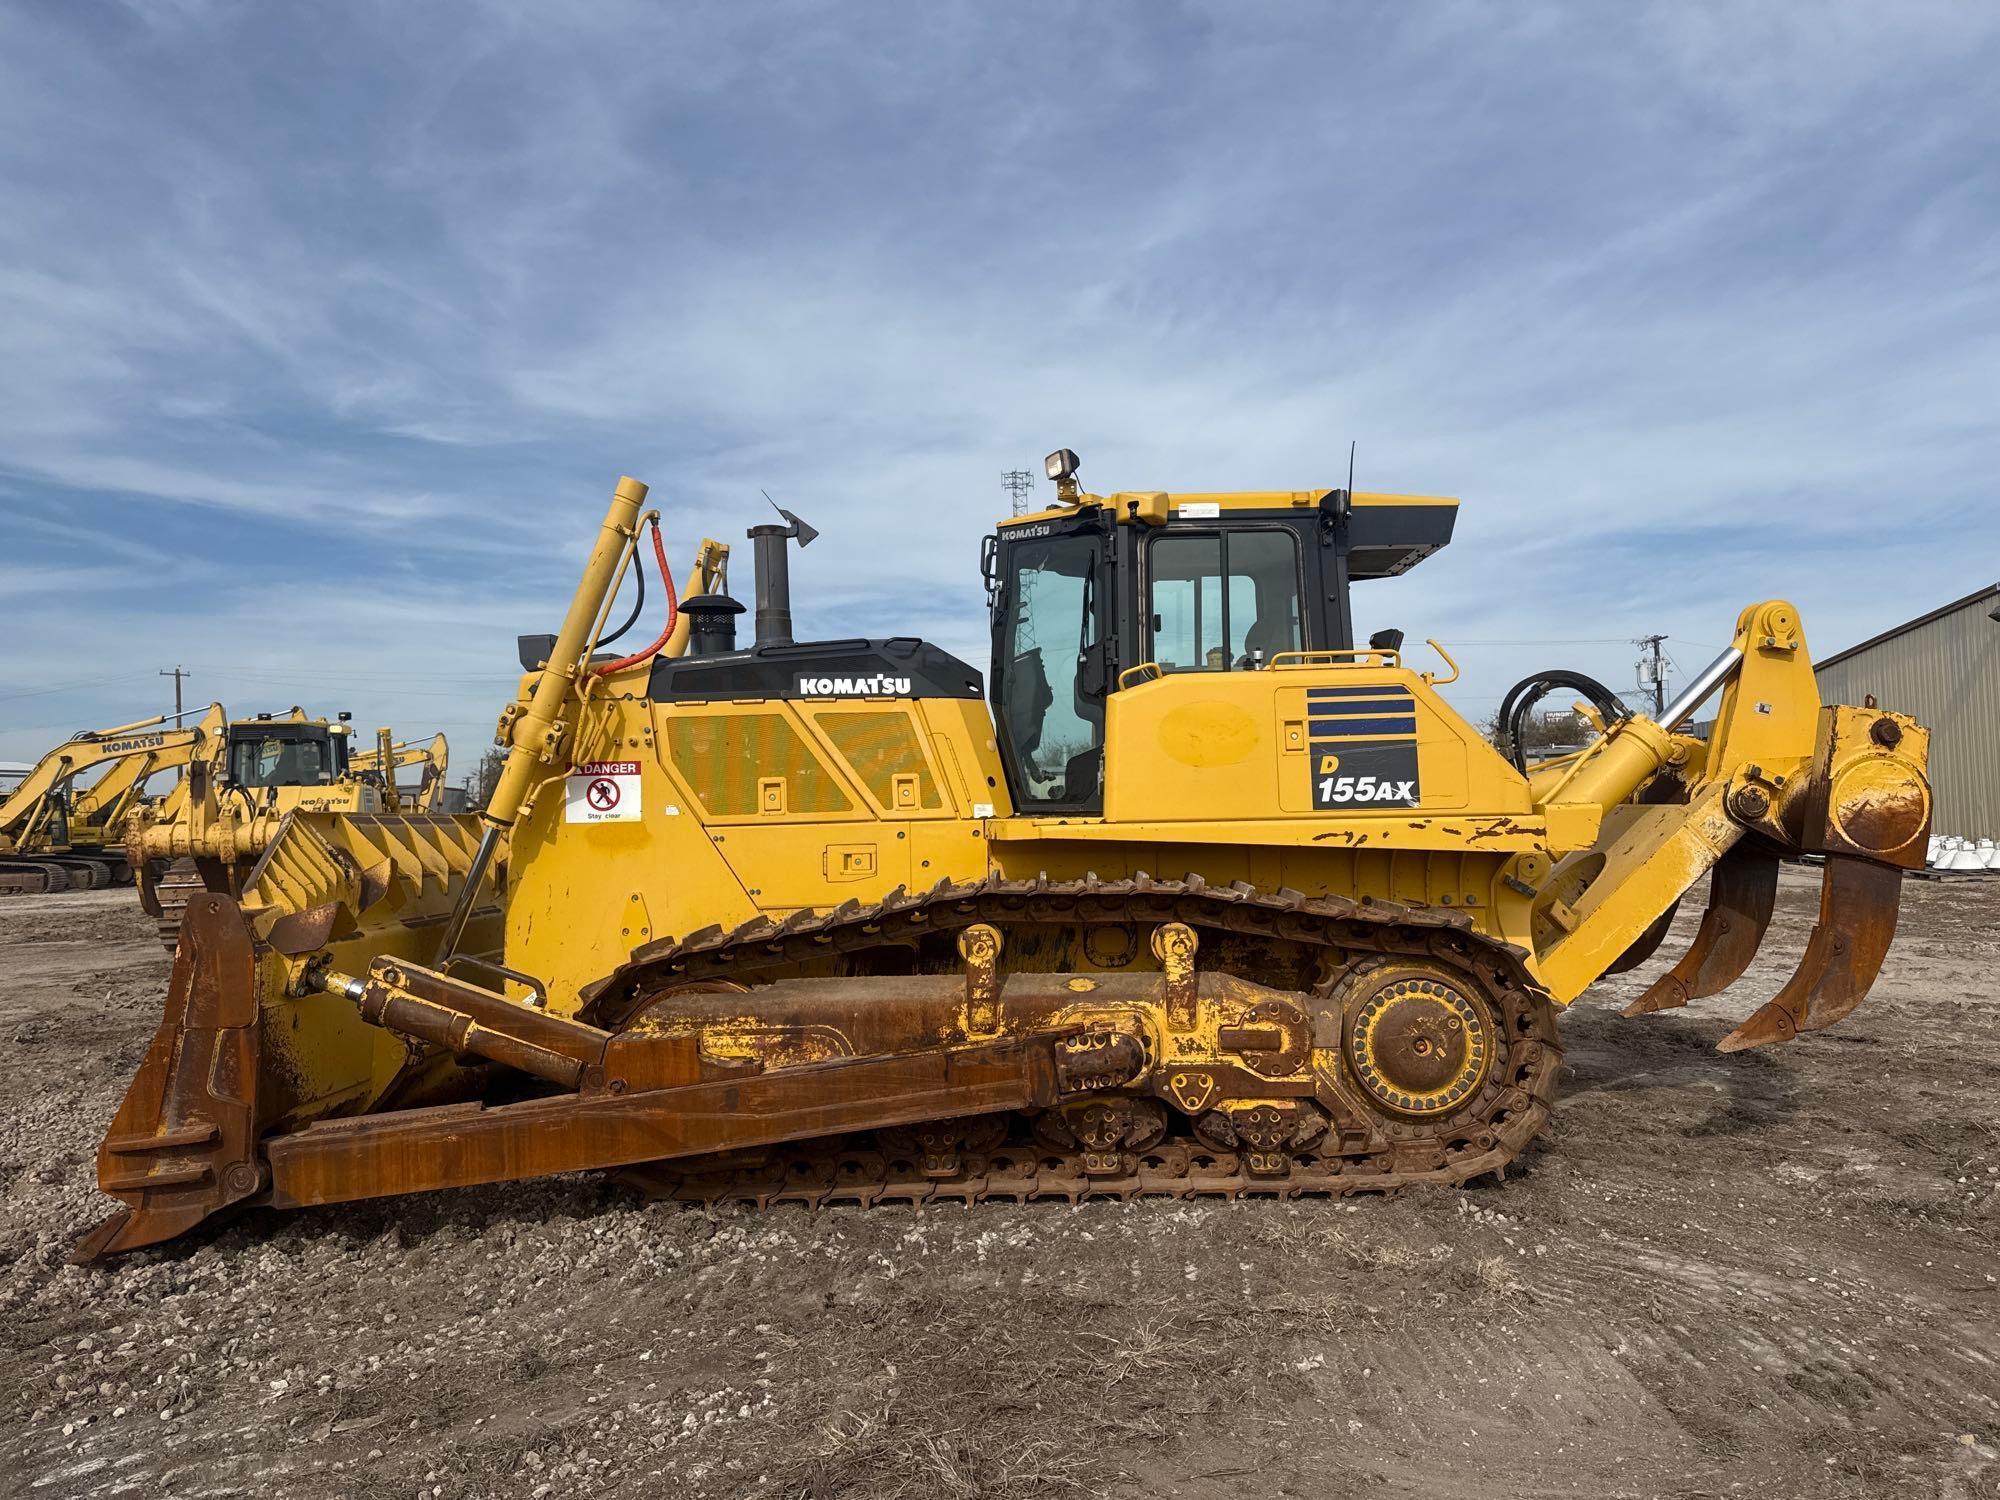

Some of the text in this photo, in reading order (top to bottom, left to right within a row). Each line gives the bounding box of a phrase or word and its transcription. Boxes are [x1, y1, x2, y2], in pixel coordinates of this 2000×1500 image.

[1002, 525, 1050, 540] KOMATSU
[800, 674, 911, 695] KOMATSU
[102, 736, 164, 753] KOMATSU
[584, 763, 636, 774] DANGER
[1320, 755, 1339, 774] D
[1319, 777, 1415, 803] 155AX
[301, 797, 350, 805] KOATSU
